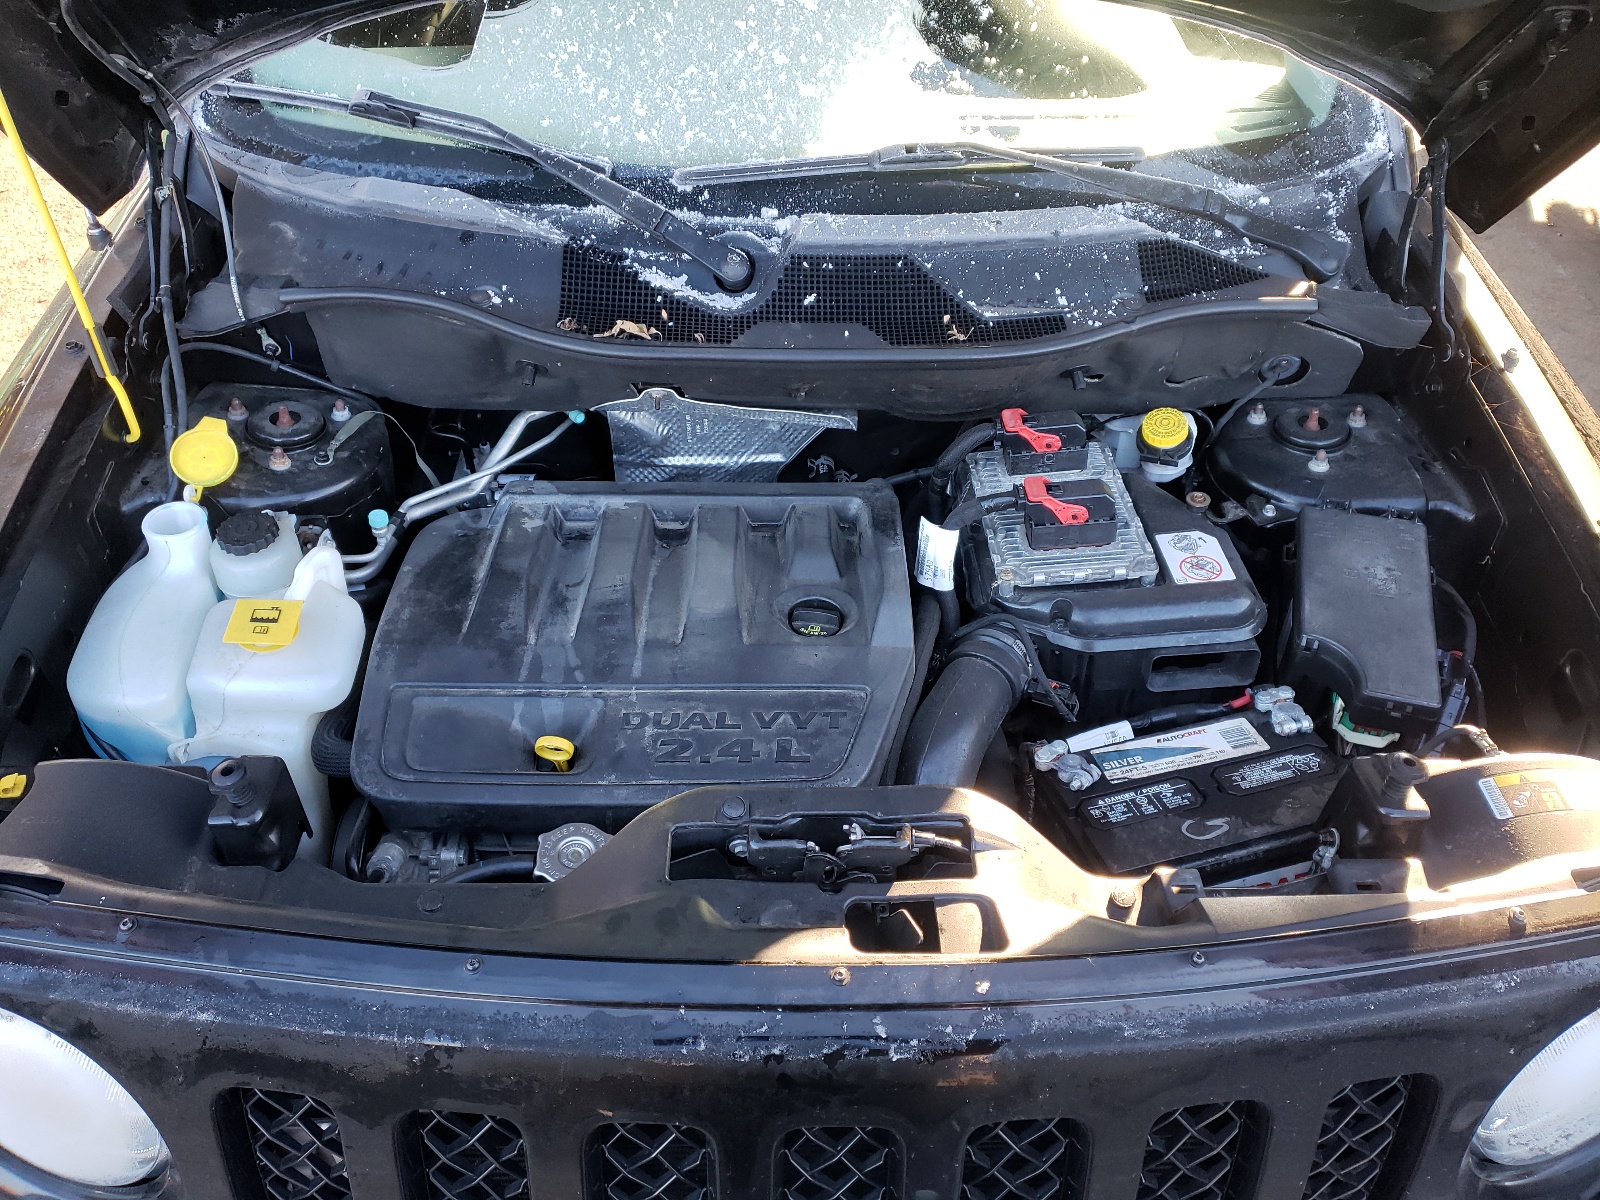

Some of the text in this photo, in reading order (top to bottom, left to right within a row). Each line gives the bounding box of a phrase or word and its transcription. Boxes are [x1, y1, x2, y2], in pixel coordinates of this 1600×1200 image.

[621, 711, 848, 730] DUAL VVT
[1162, 728, 1208, 743] AUTOCRAFT
[1102, 755, 1144, 770] SILVER
[1104, 791, 1137, 804] DANGER
[1141, 782, 1172, 794] POISON
